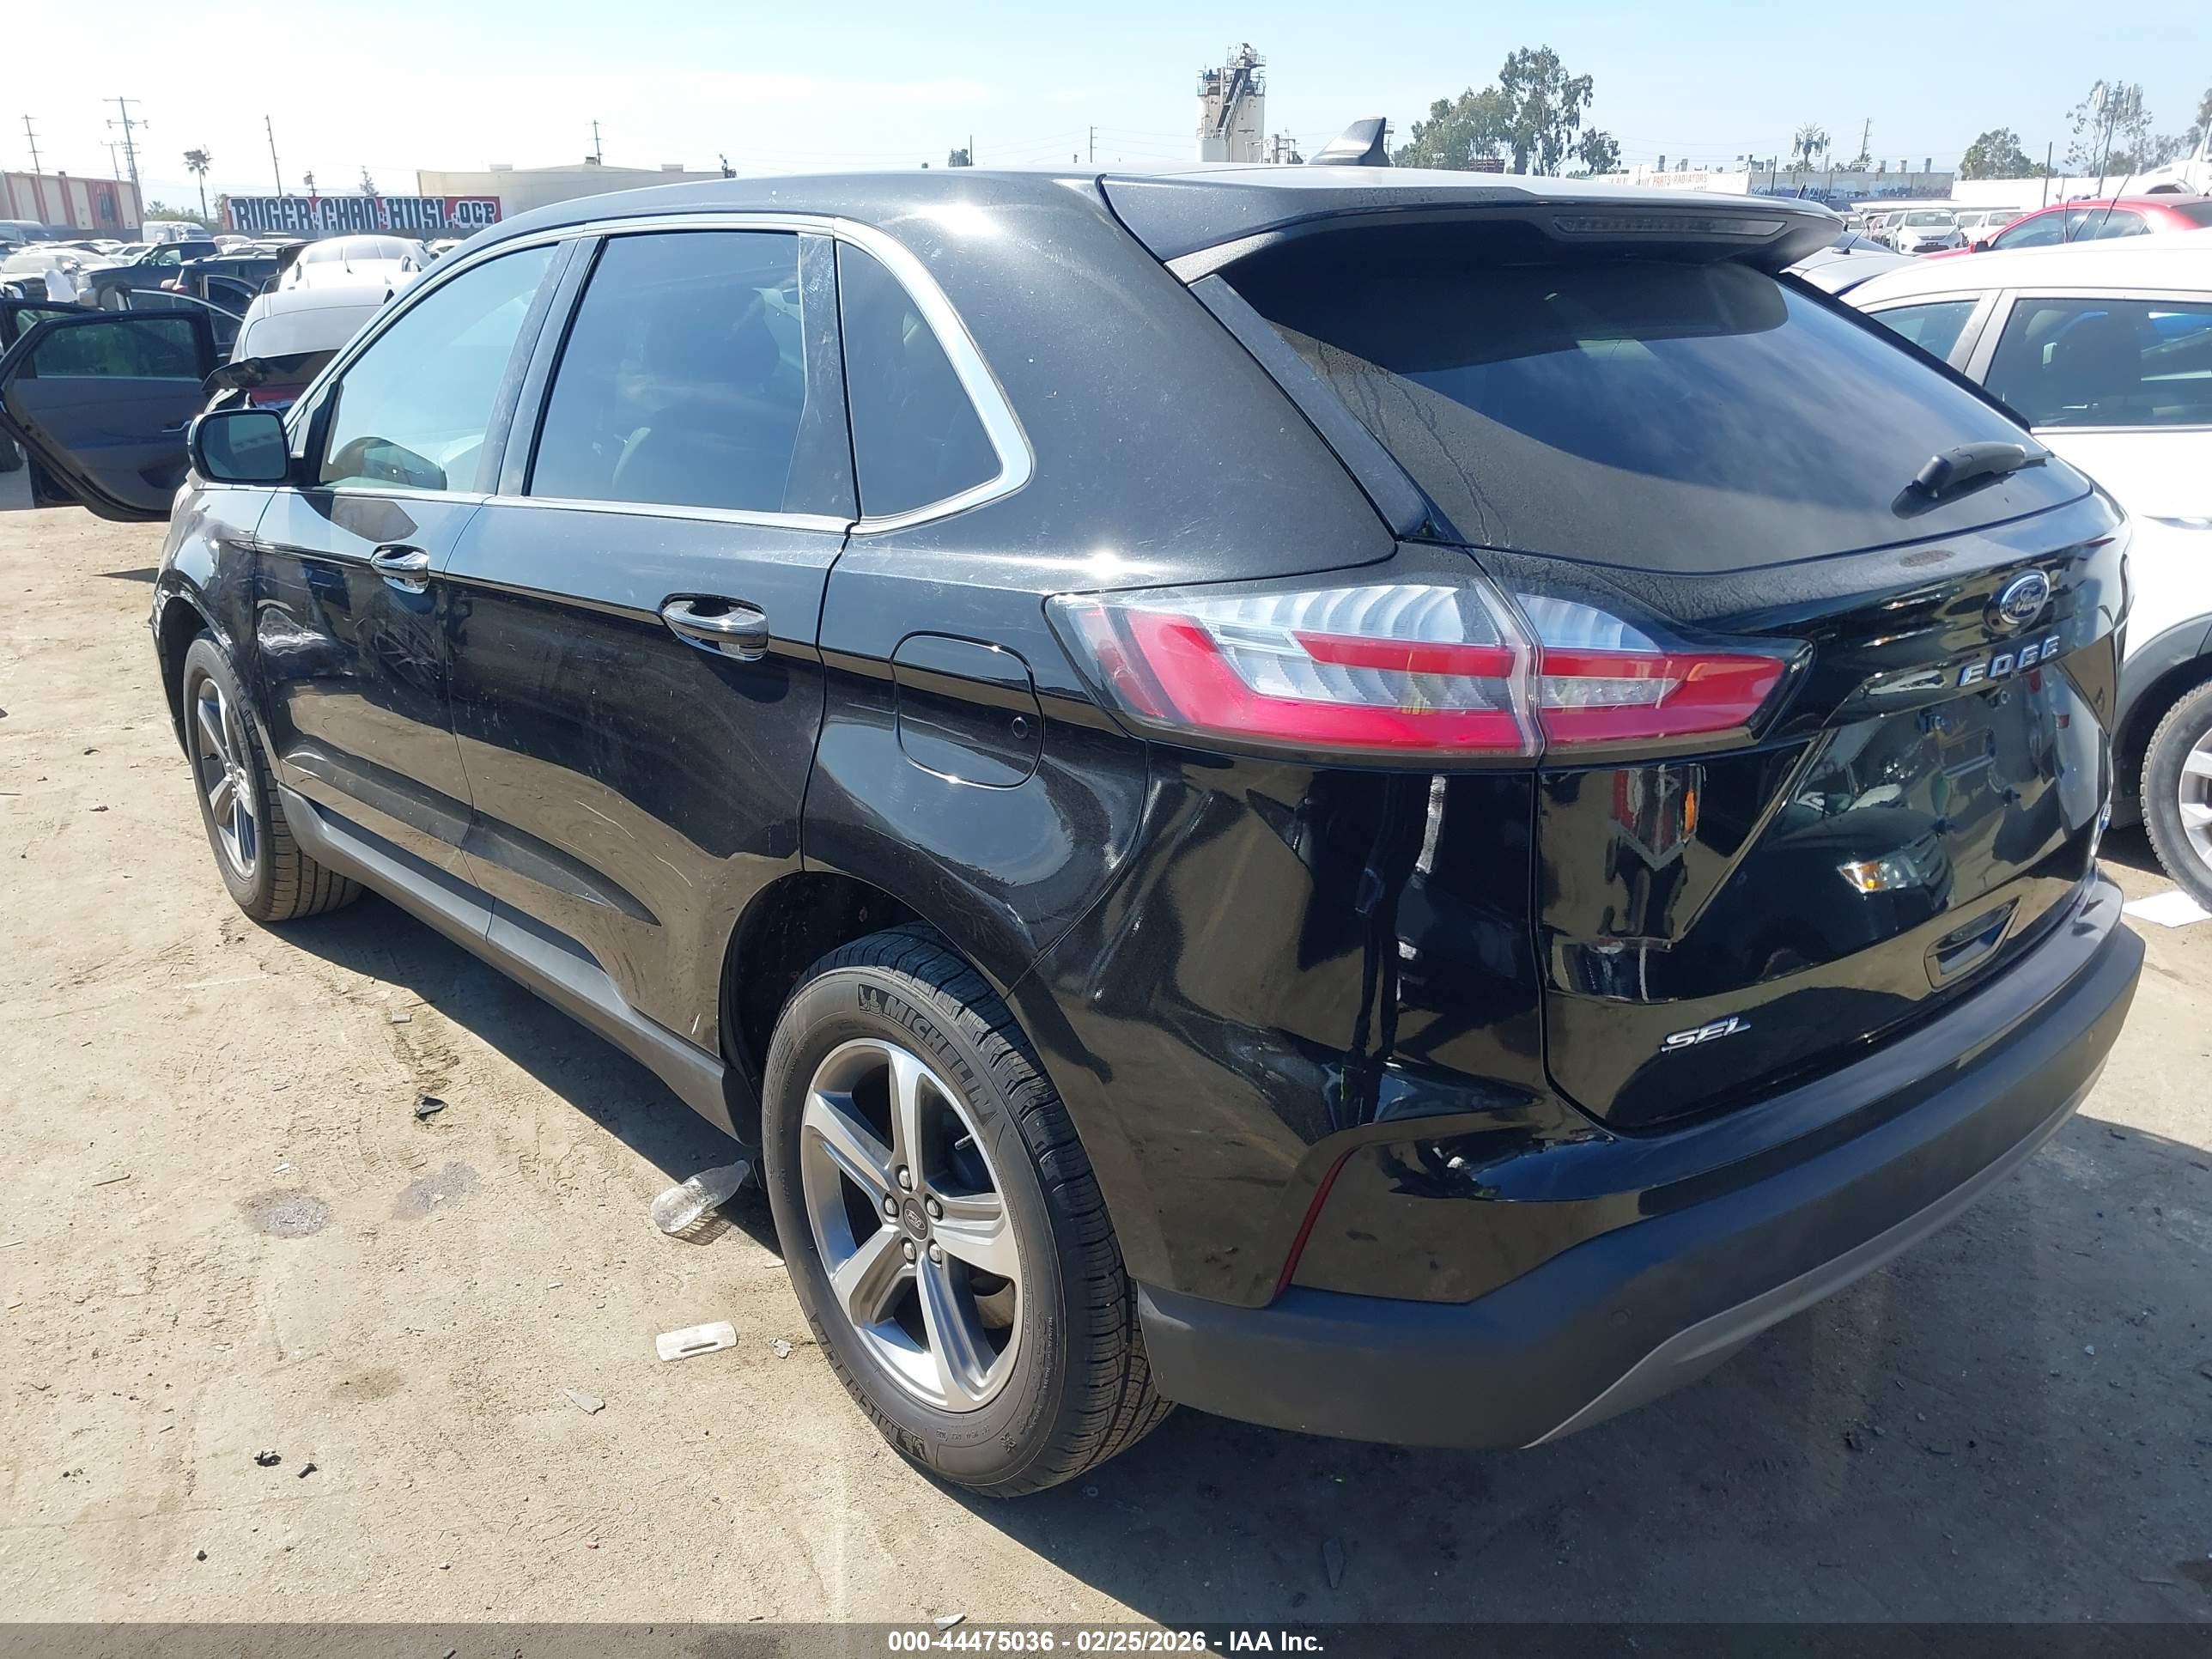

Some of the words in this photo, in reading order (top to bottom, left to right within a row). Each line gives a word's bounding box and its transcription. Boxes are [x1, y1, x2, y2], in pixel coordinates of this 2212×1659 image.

[1959, 635, 2061, 687] EDGE
[884, 995, 997, 1124] MICHELIN
[1660, 1017, 1752, 1053] SEL
